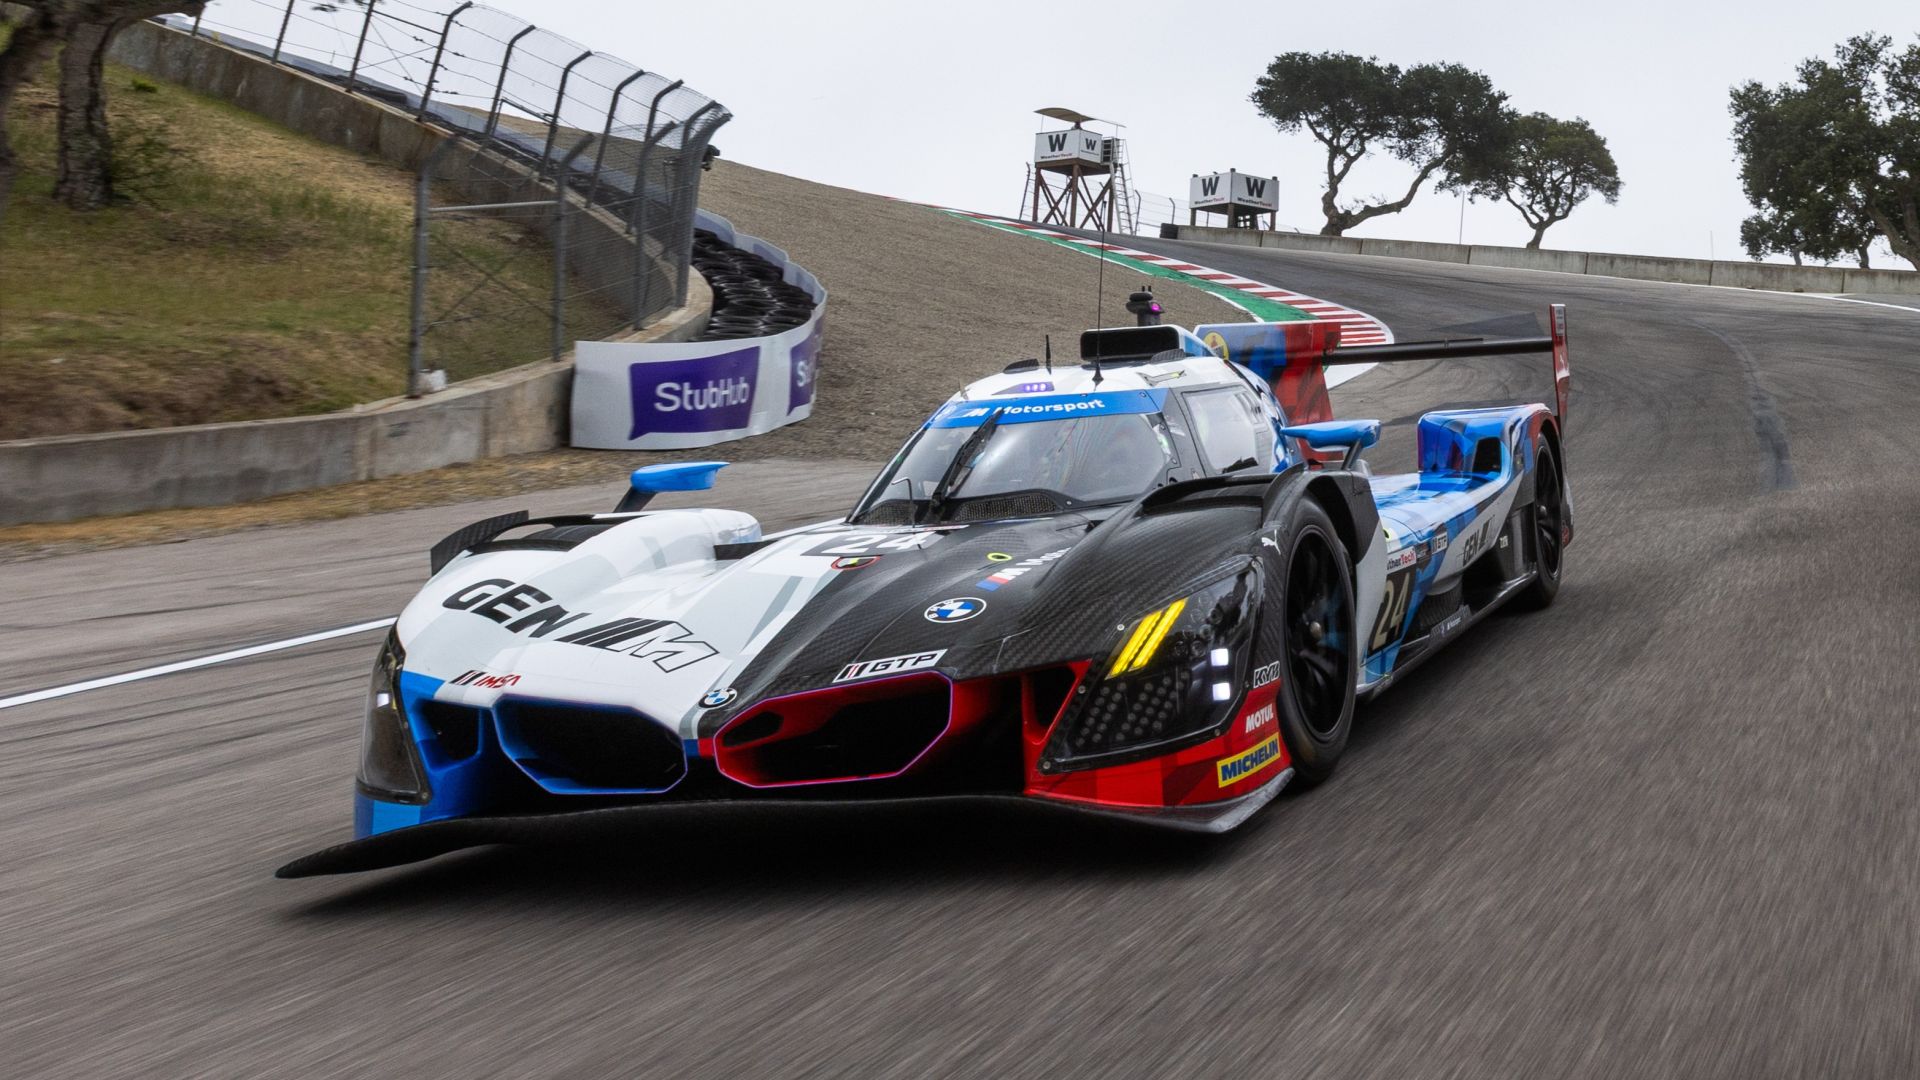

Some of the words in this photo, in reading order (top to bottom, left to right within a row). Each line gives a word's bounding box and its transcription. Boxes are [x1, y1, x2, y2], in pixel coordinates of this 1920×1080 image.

[1048, 133, 1068, 152] W
[1085, 138, 1097, 151] W
[1202, 176, 1220, 197] W
[1245, 176, 1266, 199] W
[654, 376, 750, 412] StubHub
[821, 531, 936, 554] 24
[442, 578, 592, 638] GEN
[1372, 571, 1410, 650] 24
[868, 652, 938, 674] GTP
[473, 674, 522, 689] IMSA
[1246, 703, 1274, 734] MOTUL
[1221, 738, 1279, 781] MICHELIN
